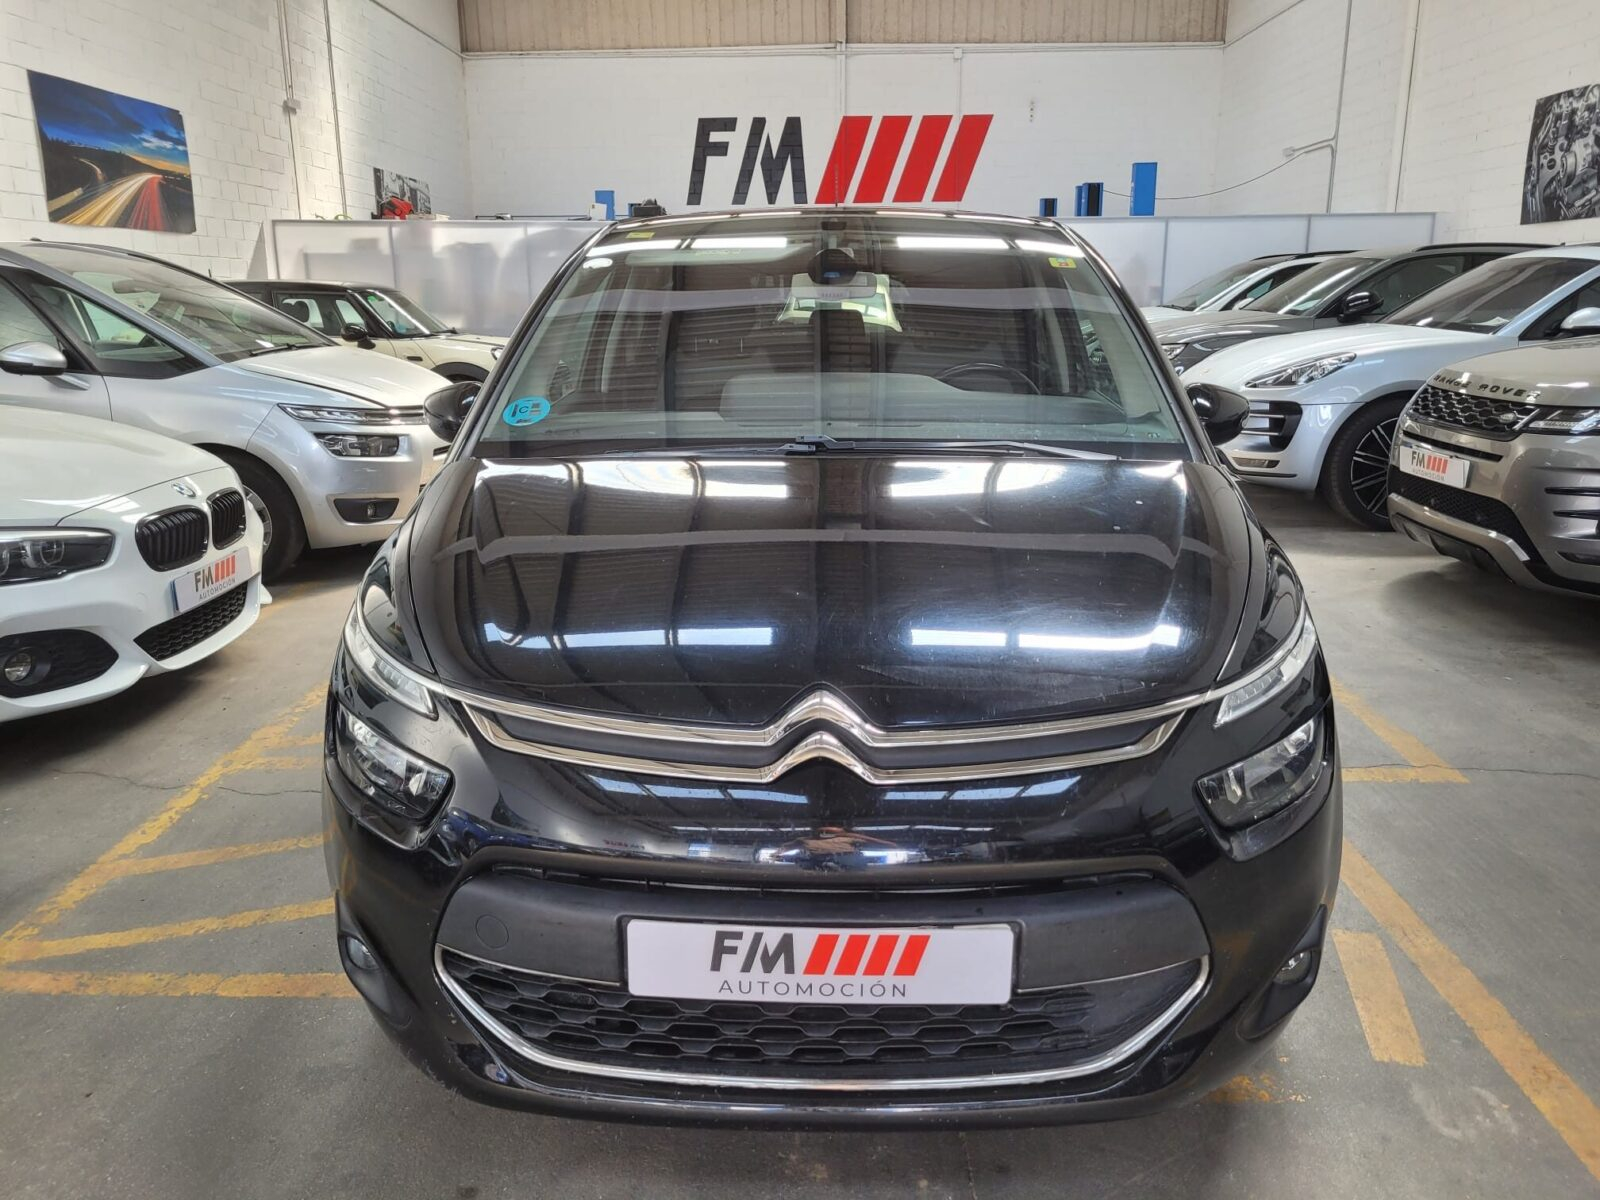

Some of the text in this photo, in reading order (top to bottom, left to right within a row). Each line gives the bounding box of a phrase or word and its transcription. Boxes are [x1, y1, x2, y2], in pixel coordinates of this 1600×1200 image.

[686, 116, 808, 206] FM
[1434, 375, 1472, 388] RANGE
[1411, 450, 1425, 469] FM
[194, 566, 214, 592] FM
[709, 930, 796, 975] FM
[718, 979, 907, 998] AUTOMOCIÓN
